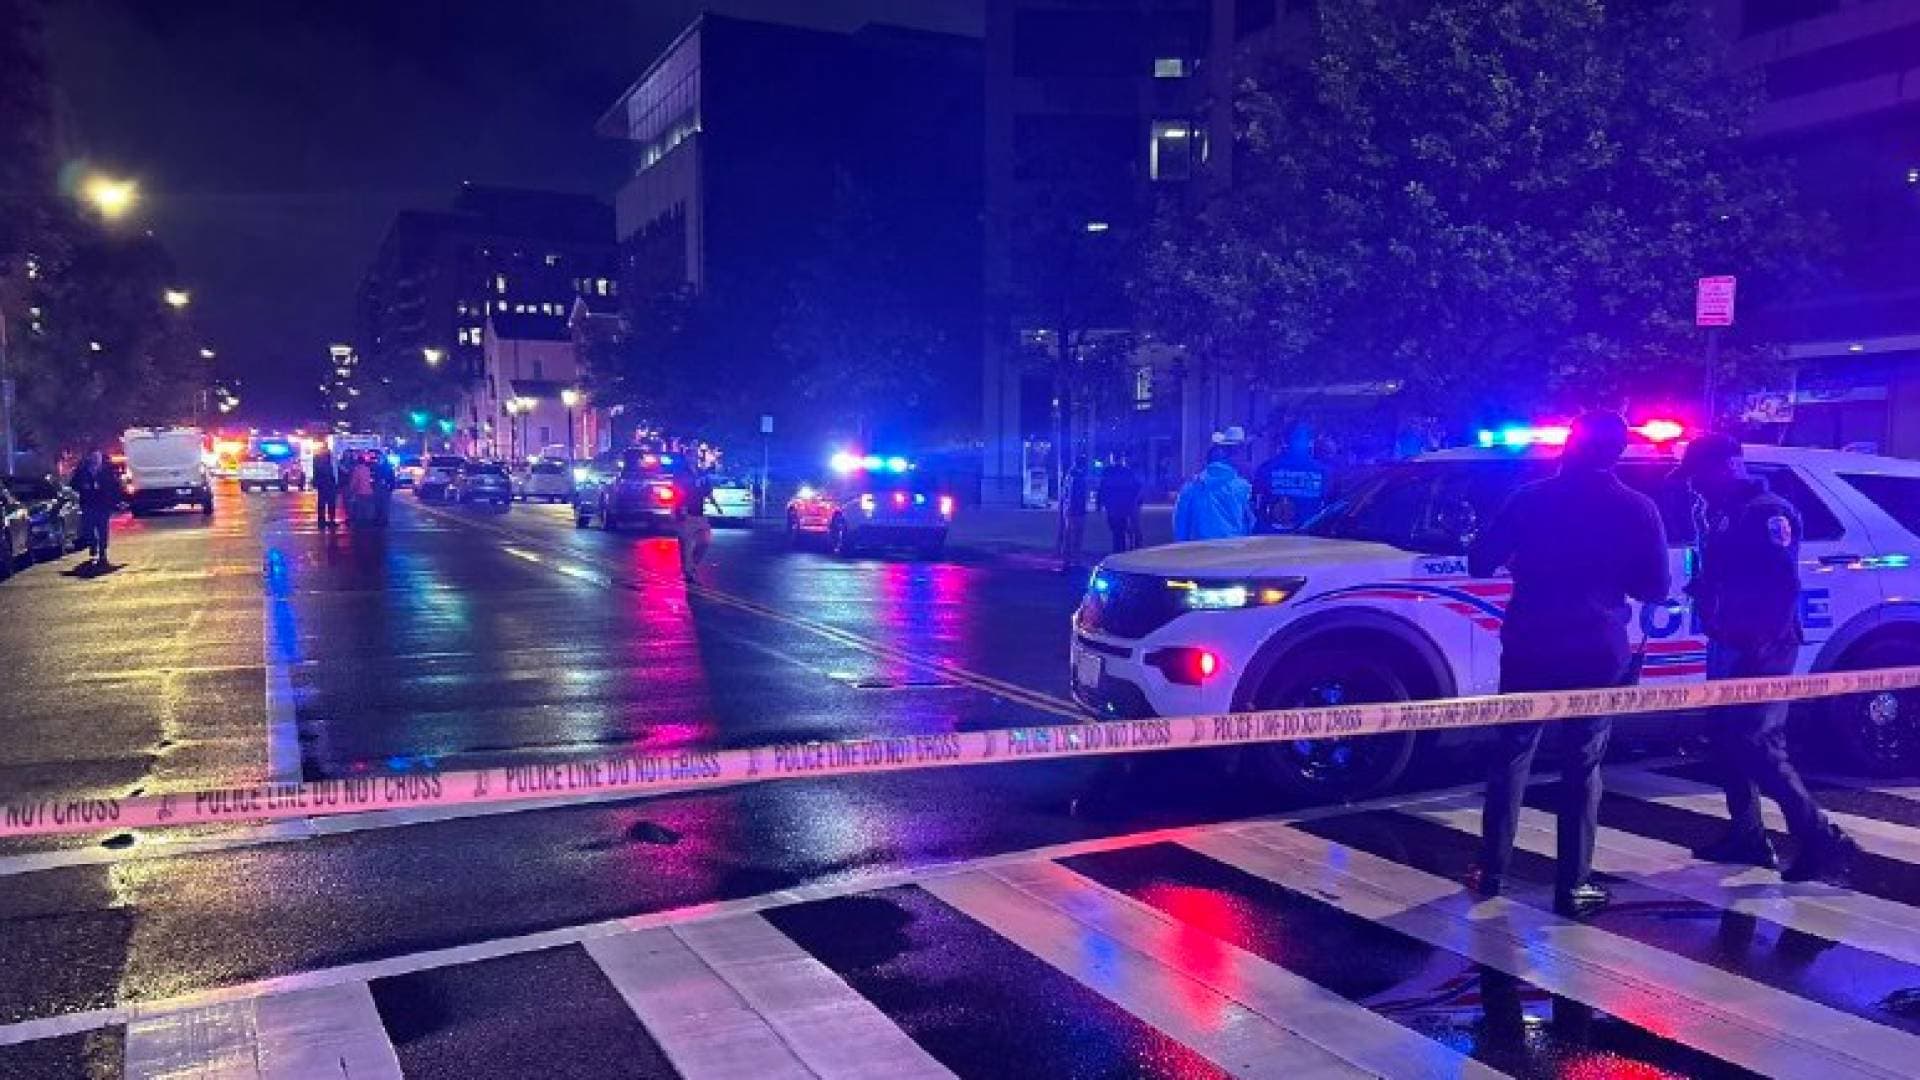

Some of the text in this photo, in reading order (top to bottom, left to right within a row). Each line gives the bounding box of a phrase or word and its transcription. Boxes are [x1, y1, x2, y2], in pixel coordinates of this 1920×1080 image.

[506, 752, 720, 792] POLICE LINE DO NOT CROSS
[196, 774, 442, 814] POLICE LINE DO NOT CROSS
